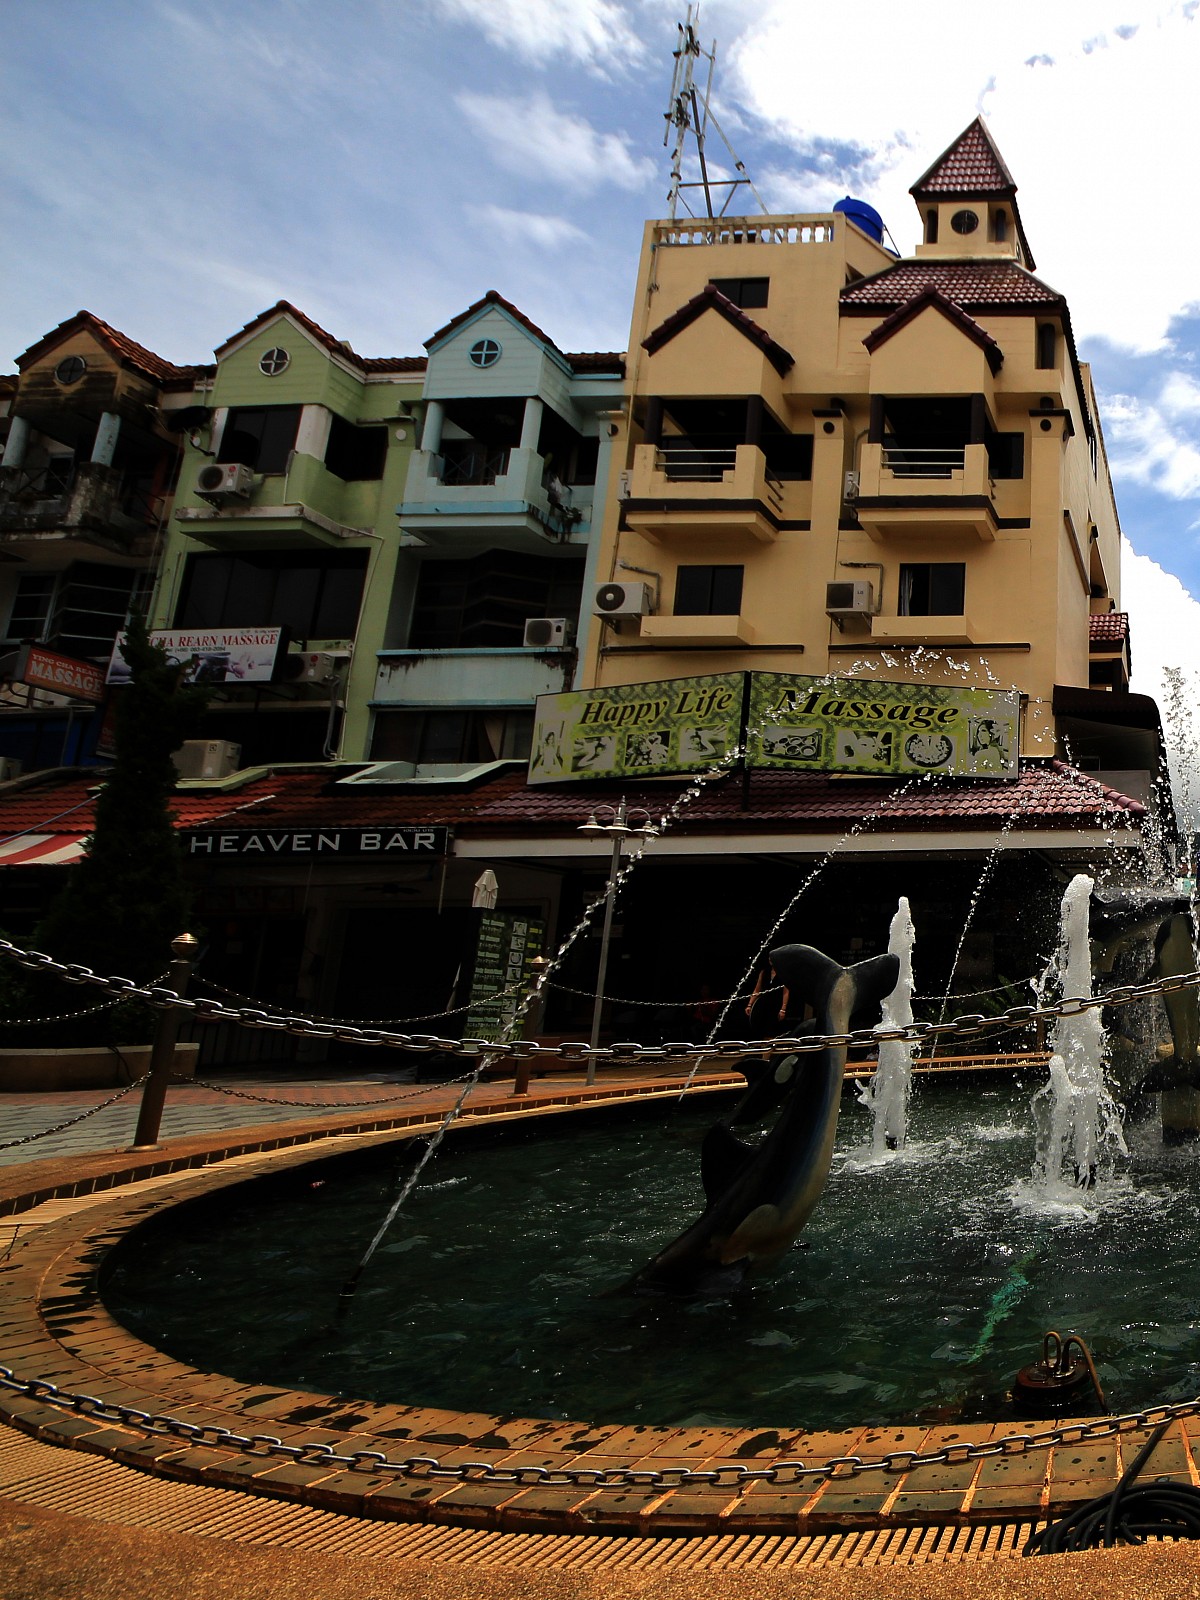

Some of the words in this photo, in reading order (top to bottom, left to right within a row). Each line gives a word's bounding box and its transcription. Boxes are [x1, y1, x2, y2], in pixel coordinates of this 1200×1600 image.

[179, 635, 217, 647] REARN
[221, 633, 278, 646] MASSAGE
[32, 653, 55, 665] YING
[56, 661, 74, 671] CHA
[29, 660, 104, 693] MASSAGE
[578, 700, 668, 728] Happy
[673, 687, 733, 719] Life
[772, 689, 959, 729] Massage
[189, 833, 341, 853] HEAVEN
[359, 832, 436, 851] BAR
